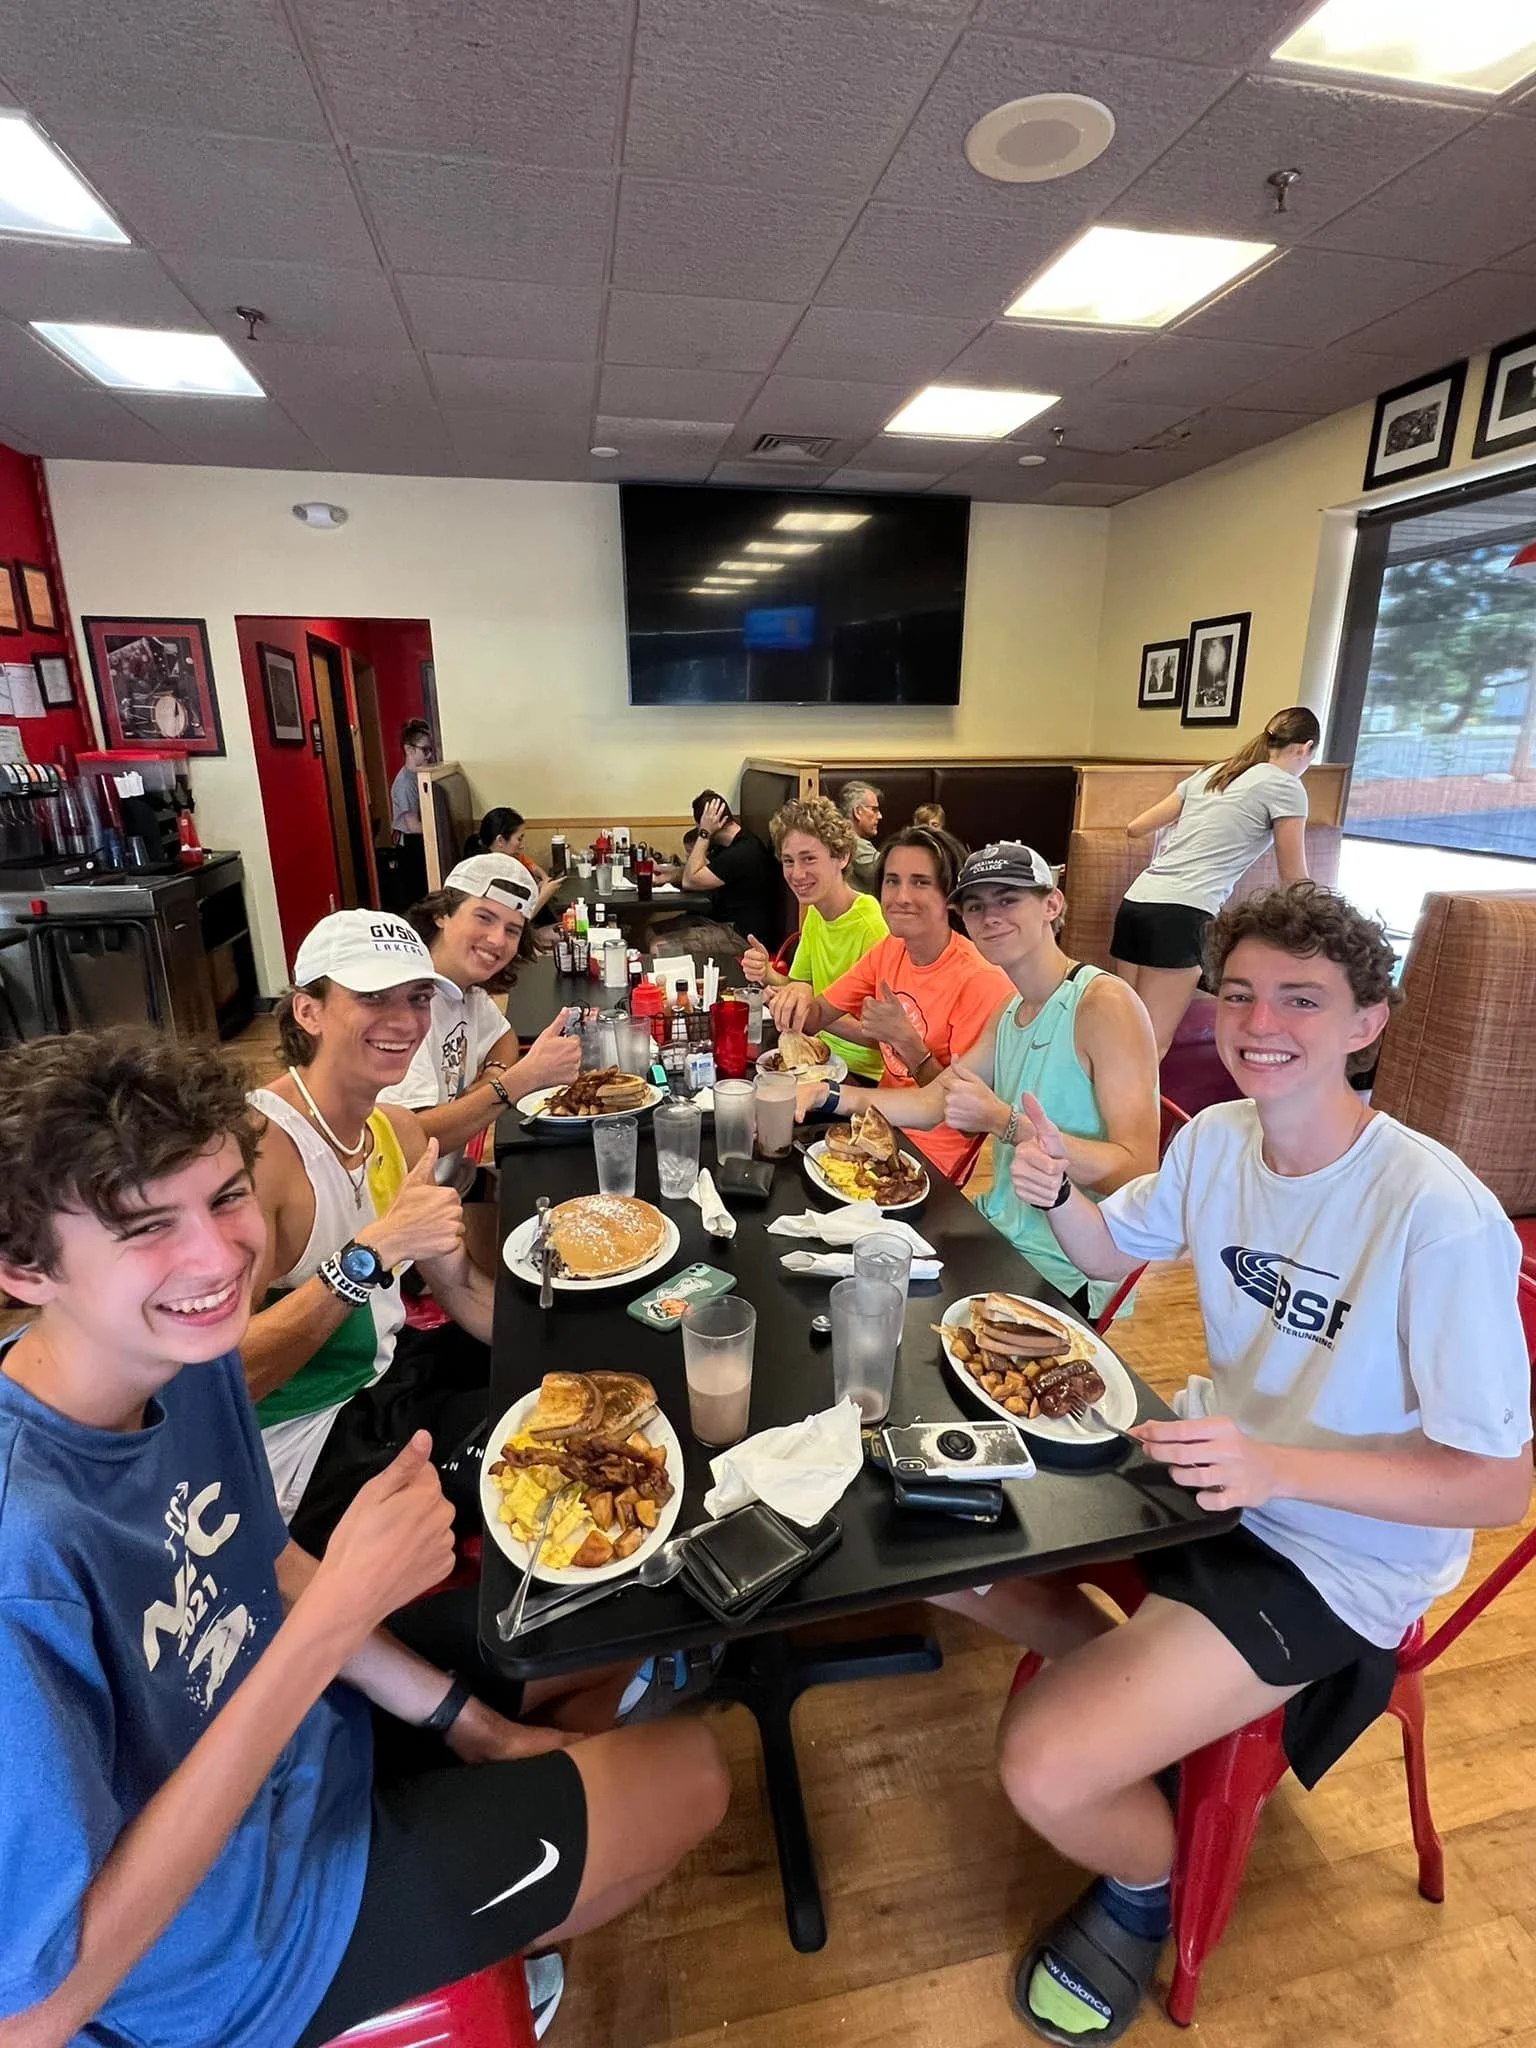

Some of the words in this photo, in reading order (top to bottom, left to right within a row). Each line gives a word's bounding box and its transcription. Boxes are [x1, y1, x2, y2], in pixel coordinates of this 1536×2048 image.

[972, 864, 1003, 874] COLLEGE
[370, 923, 418, 943] GVSU
[1060, 1971, 1112, 2015] balance
